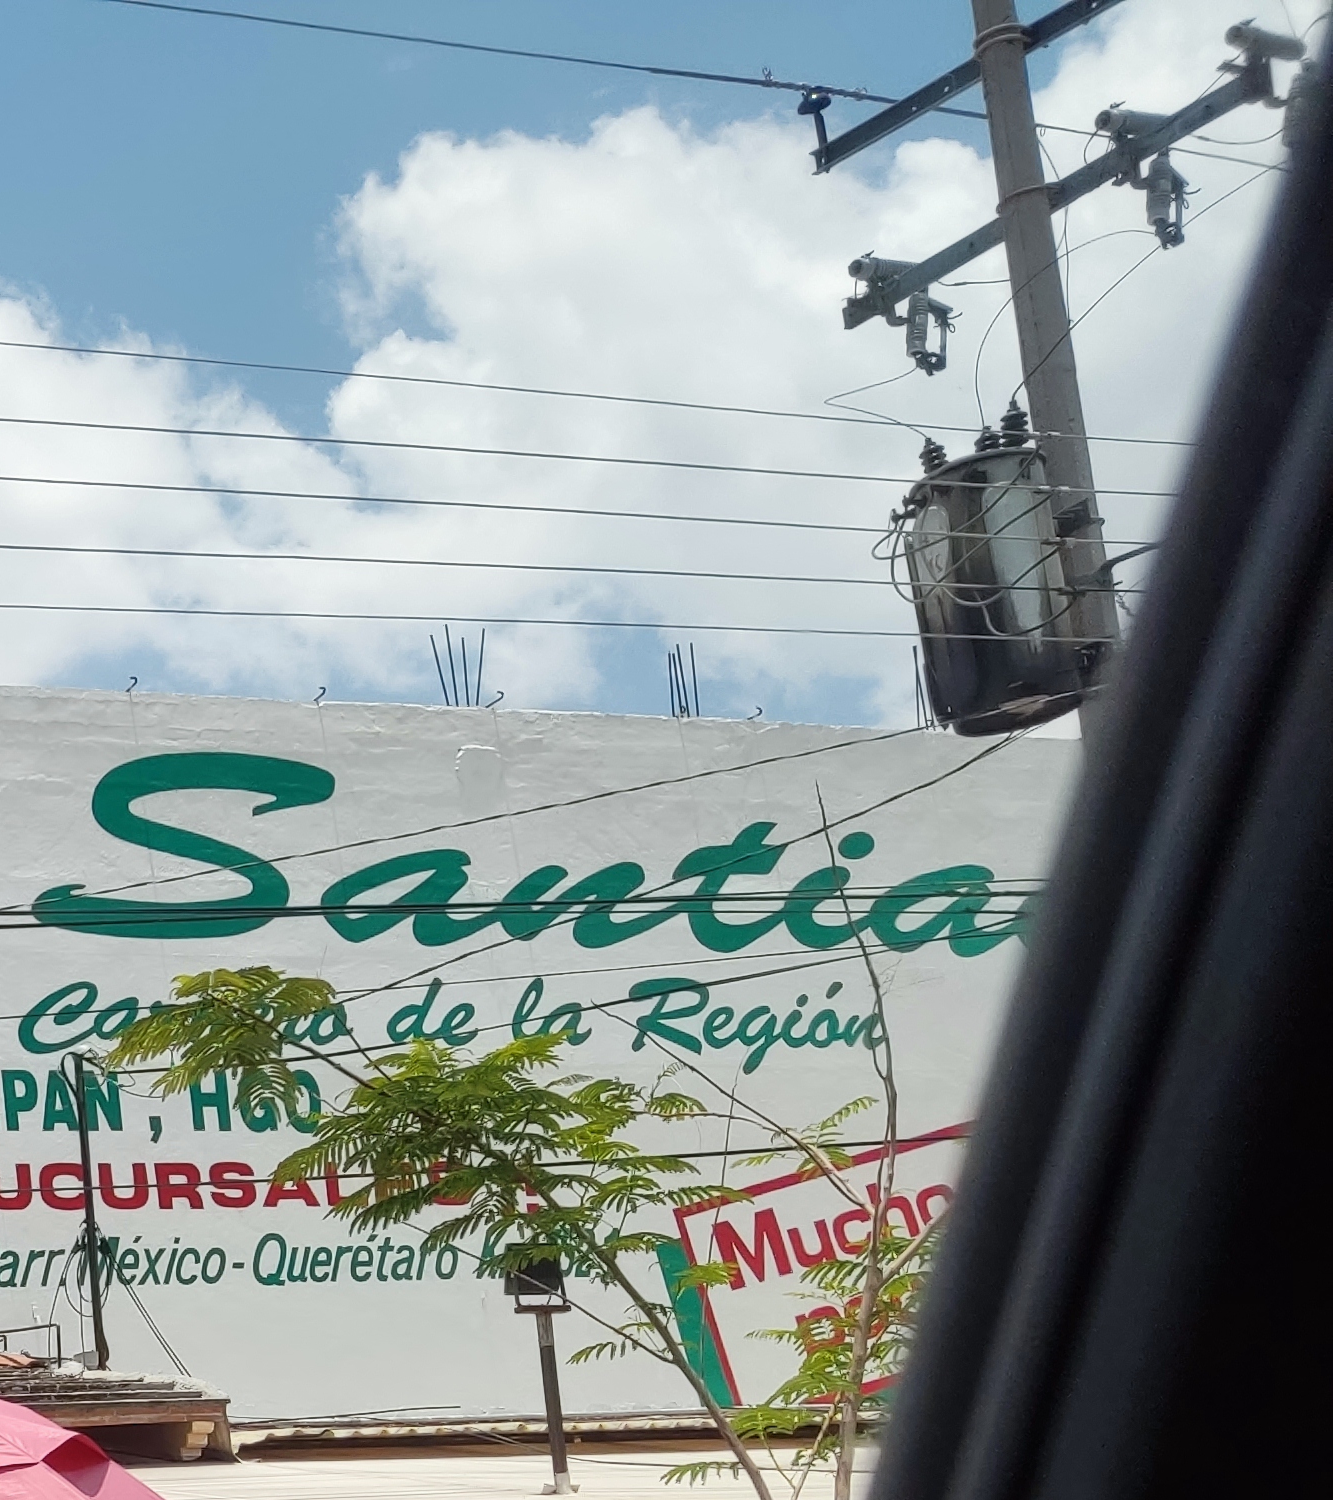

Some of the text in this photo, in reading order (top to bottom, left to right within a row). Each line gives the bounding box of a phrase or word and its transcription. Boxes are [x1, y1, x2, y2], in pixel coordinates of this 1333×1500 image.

[31, 751, 1037, 958] Santia
[386, 977, 479, 1047] de
[511, 977, 593, 1047] la
[631, 977, 891, 1075] Región
